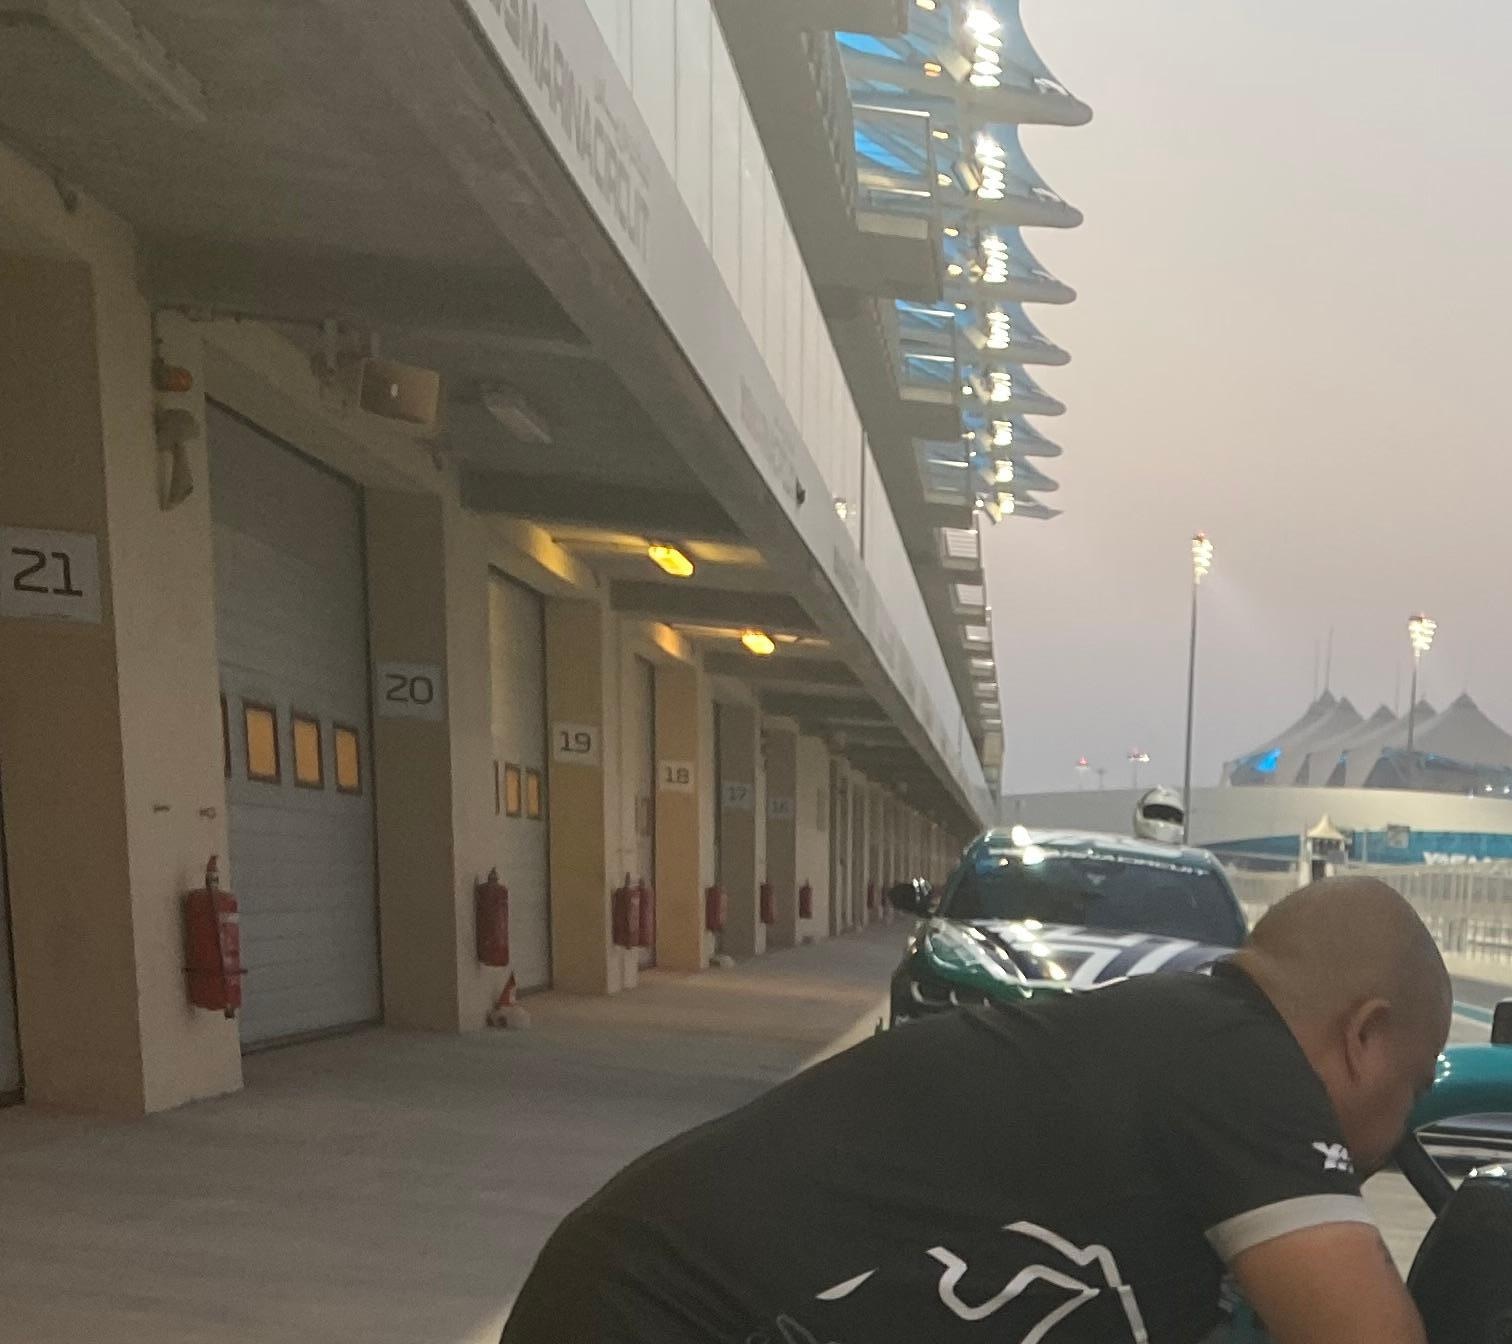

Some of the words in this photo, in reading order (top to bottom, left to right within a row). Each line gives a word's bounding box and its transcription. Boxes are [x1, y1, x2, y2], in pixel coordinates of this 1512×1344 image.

[11, 547, 83, 597] 21
[386, 674, 434, 705] 20
[560, 731, 592, 754] 19
[665, 766, 690, 784] 18
